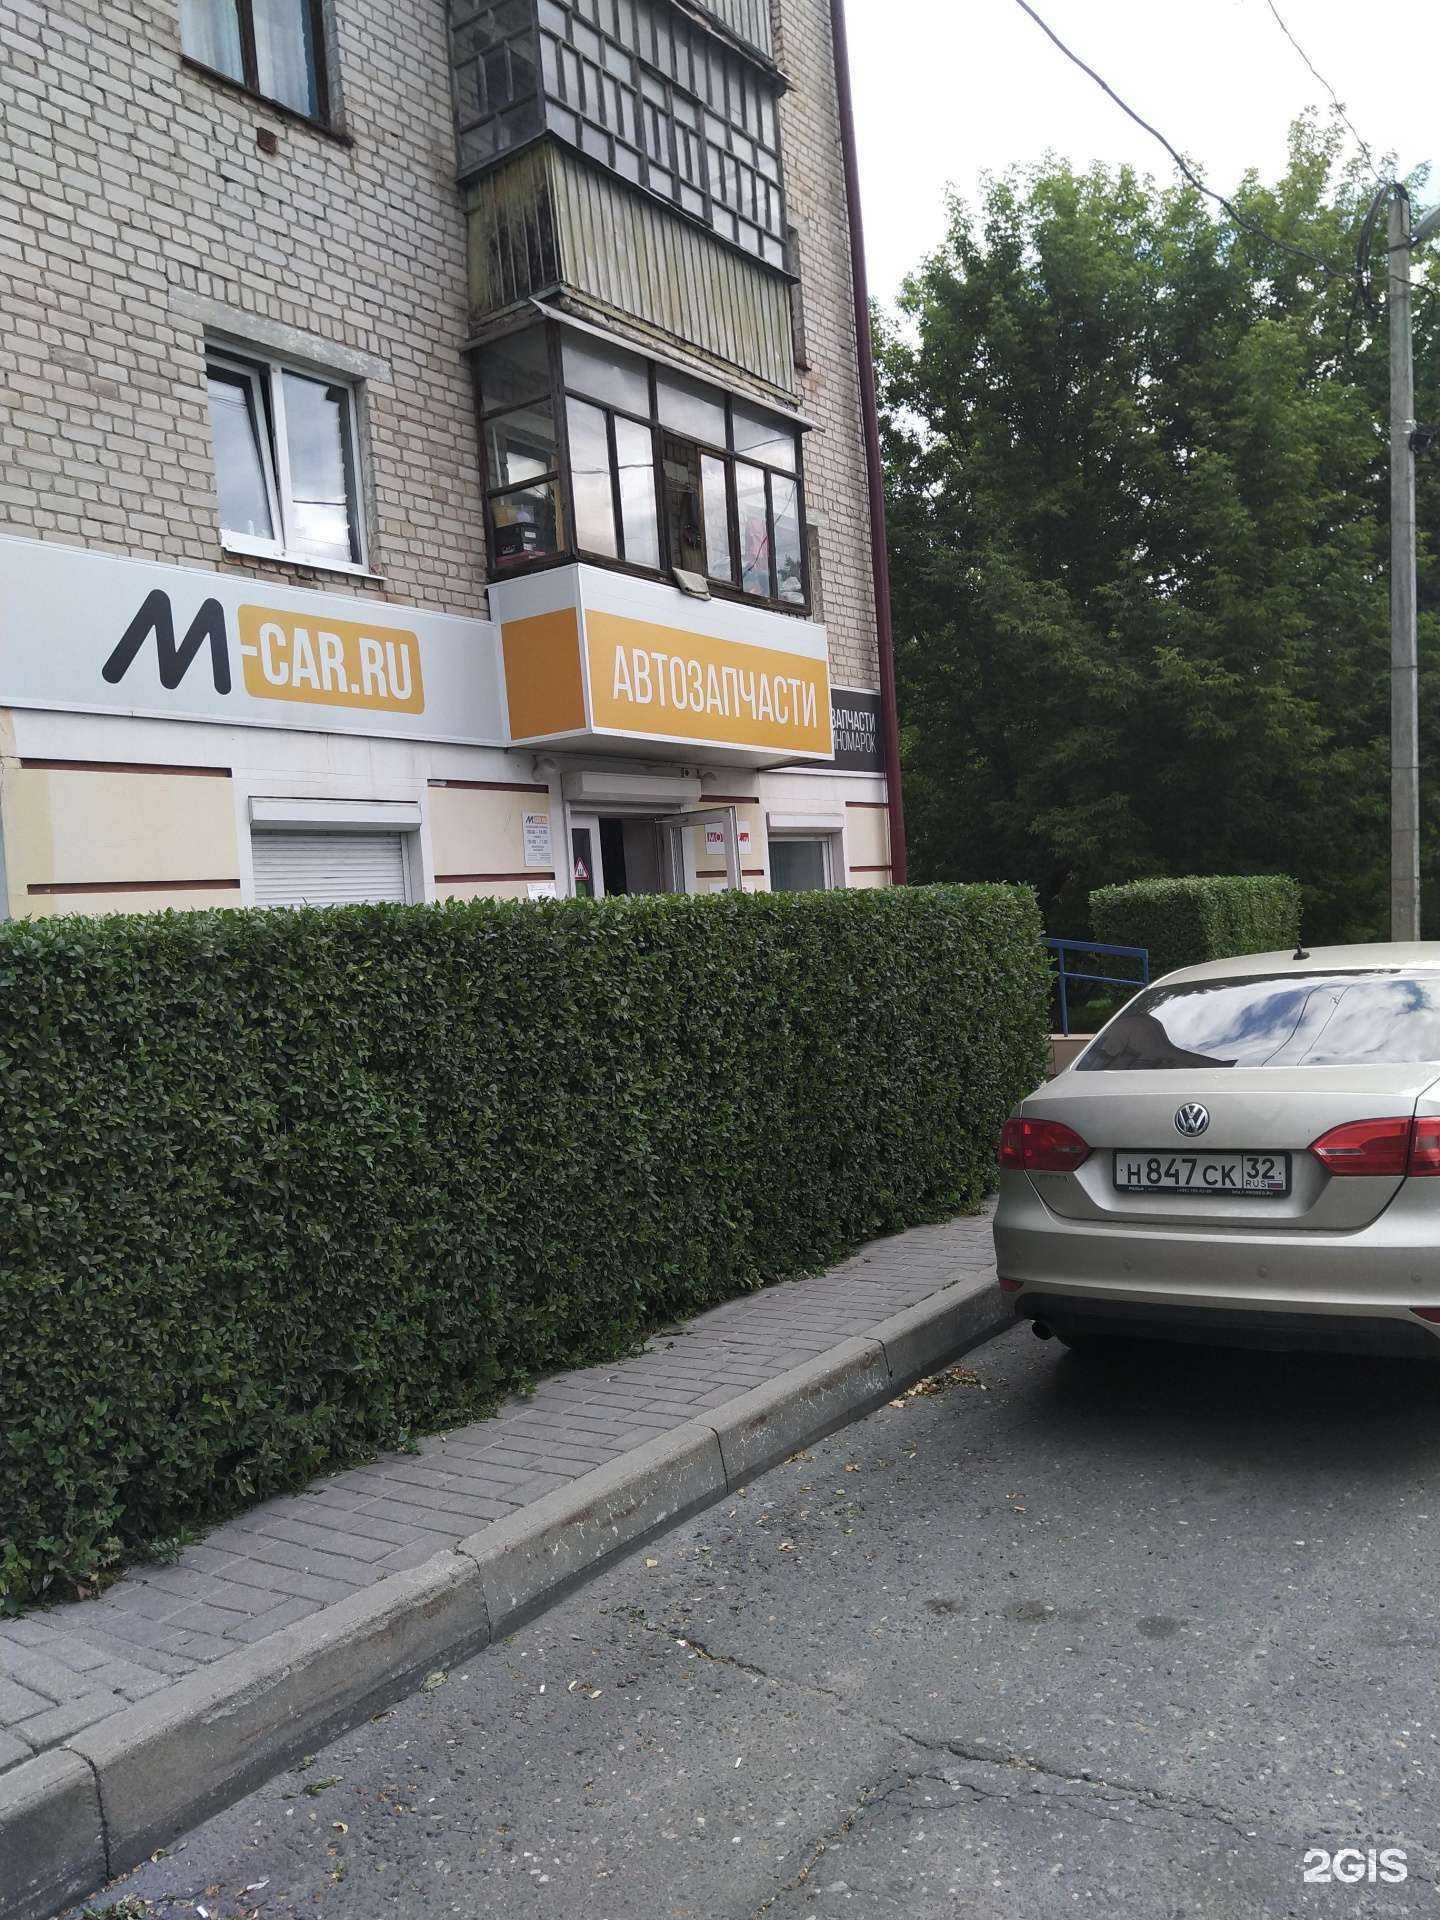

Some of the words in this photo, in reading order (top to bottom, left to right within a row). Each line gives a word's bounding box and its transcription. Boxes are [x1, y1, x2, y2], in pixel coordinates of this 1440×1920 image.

[612, 645, 818, 729] АВТОЗАПЧАСТИ
[1246, 1157, 1275, 1180] 32
[1245, 1179, 1267, 1188] RUS
